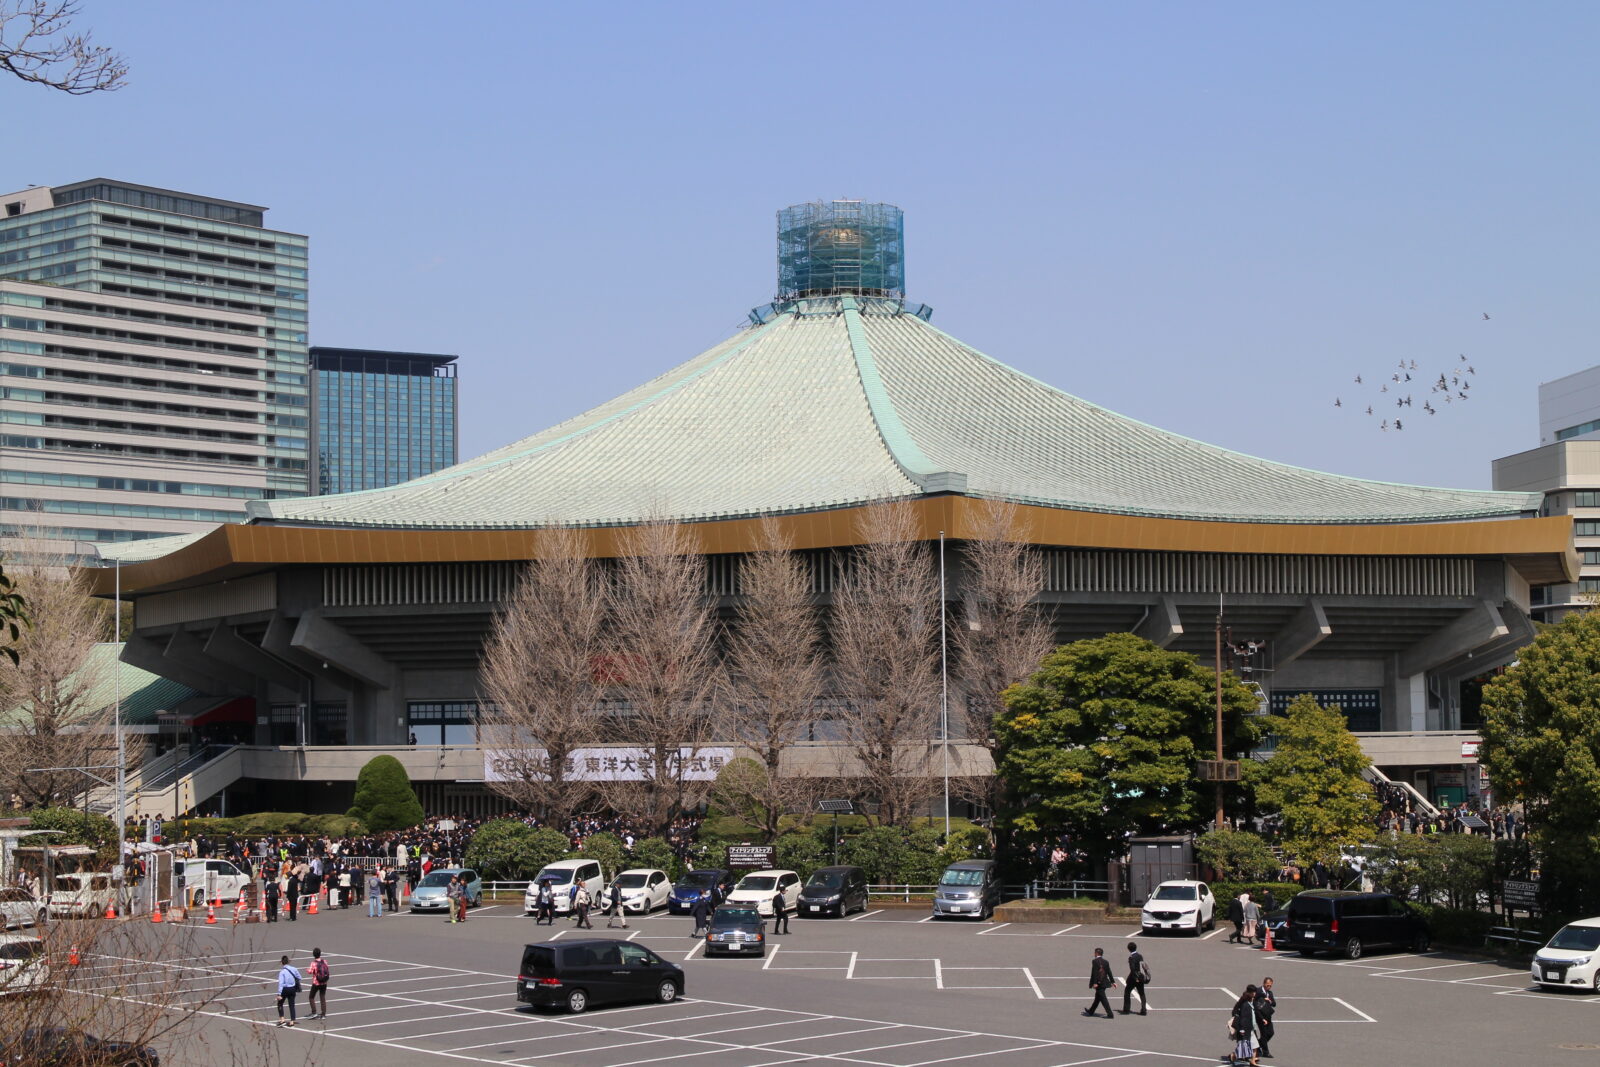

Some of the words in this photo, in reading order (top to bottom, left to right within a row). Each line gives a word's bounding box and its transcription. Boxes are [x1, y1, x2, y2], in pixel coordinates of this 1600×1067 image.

[585, 756, 724, 773] 東洋大学学式場
[154, 823, 160, 835] P
